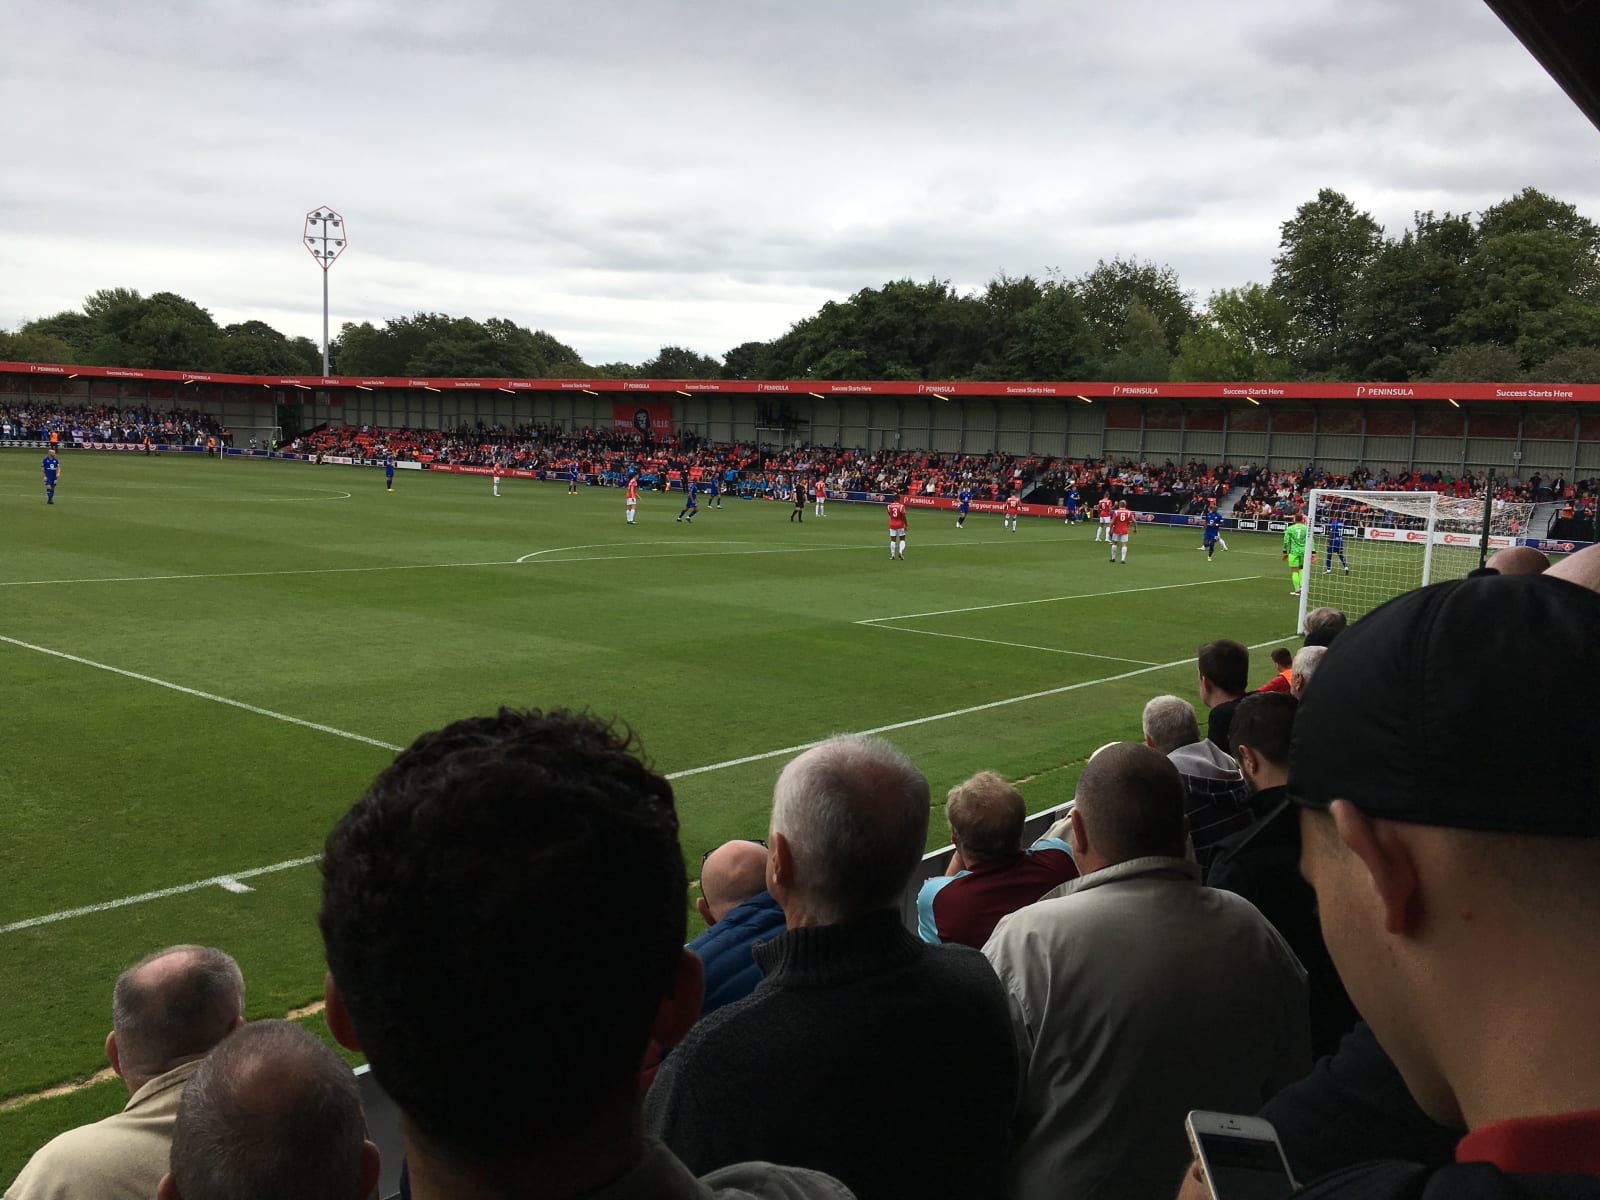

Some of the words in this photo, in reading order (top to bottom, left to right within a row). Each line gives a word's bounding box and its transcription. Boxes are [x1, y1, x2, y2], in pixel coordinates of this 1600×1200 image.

[1368, 388, 1414, 396] PENINSULA
[1496, 389, 1527, 397] Success
[1528, 389, 1552, 397] Starts
[1553, 390, 1573, 398] Here
[892, 507, 898, 517] 3
[1120, 512, 1126, 522] 6
